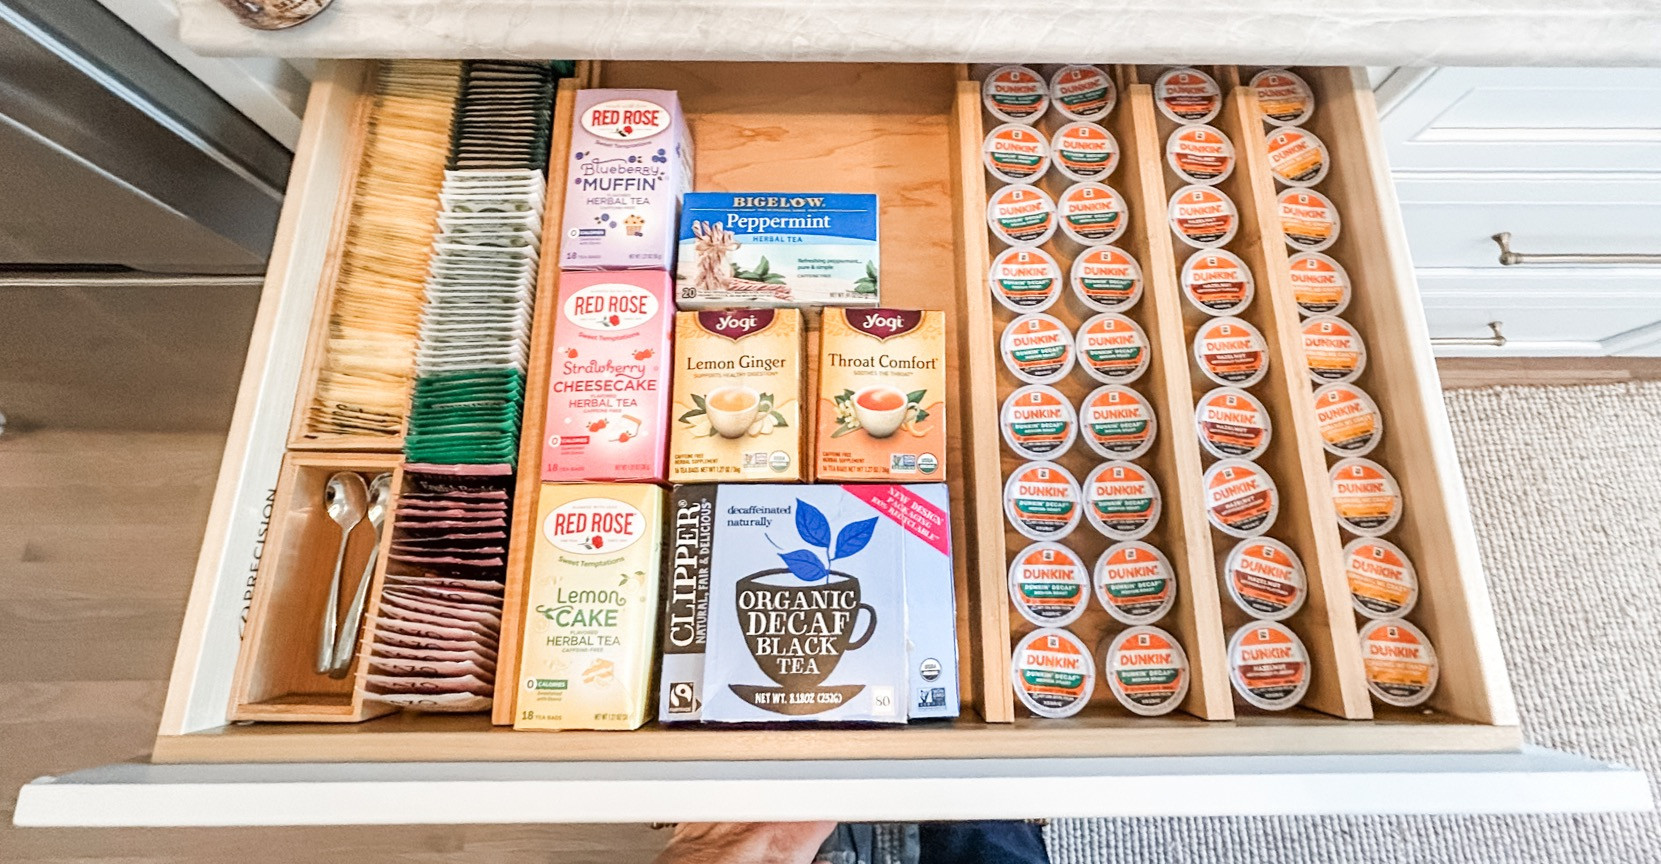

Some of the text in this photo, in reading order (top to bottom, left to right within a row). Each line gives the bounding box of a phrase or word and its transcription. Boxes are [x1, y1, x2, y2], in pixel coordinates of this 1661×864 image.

[592, 110, 660, 127] RED ROSE
[583, 178, 656, 191] MUFFIN
[586, 197, 651, 205] HERBAL TEA
[733, 197, 824, 208] BIGELOW
[726, 213, 831, 233] Peppermint
[566, 252, 577, 260] 18
[682, 287, 697, 298] 20
[575, 295, 648, 316] RED ROSE
[687, 355, 787, 371] Lemon Ginger
[828, 353, 936, 369] Throat Comfort
[563, 359, 646, 380] Strawberry
[553, 380, 657, 393] CHEESECAKE
[568, 398, 638, 408] HERBAL TEA
[547, 463, 558, 472] 18
[727, 505, 792, 514] decaffeinated
[887, 486, 941, 526] NEW DESIGN
[887, 497, 932, 529] PACKAGING
[554, 512, 634, 536] RED ROSE
[727, 516, 773, 528] naturally
[558, 556, 625, 568] Sweet Temptations
[695, 501, 712, 644] NATURAL, FAIR & DELICIOUS
[1023, 568, 1074, 581] DUNKIN'
[1108, 565, 1157, 580] DUNKIN'
[557, 588, 626, 606] Lemon
[738, 590, 858, 610] ORGANIC
[555, 608, 619, 628] CAKE
[746, 611, 851, 636] DECAF
[546, 636, 621, 646] HERBAL TEA
[755, 637, 840, 656] BLACK
[776, 657, 821, 675] TEA
[1027, 655, 1079, 670] DUNKIN'
[1120, 654, 1171, 666] DUNKIN'
[755, 692, 771, 704] NET
[772, 692, 787, 704] WT.
[522, 711, 534, 720] 18
